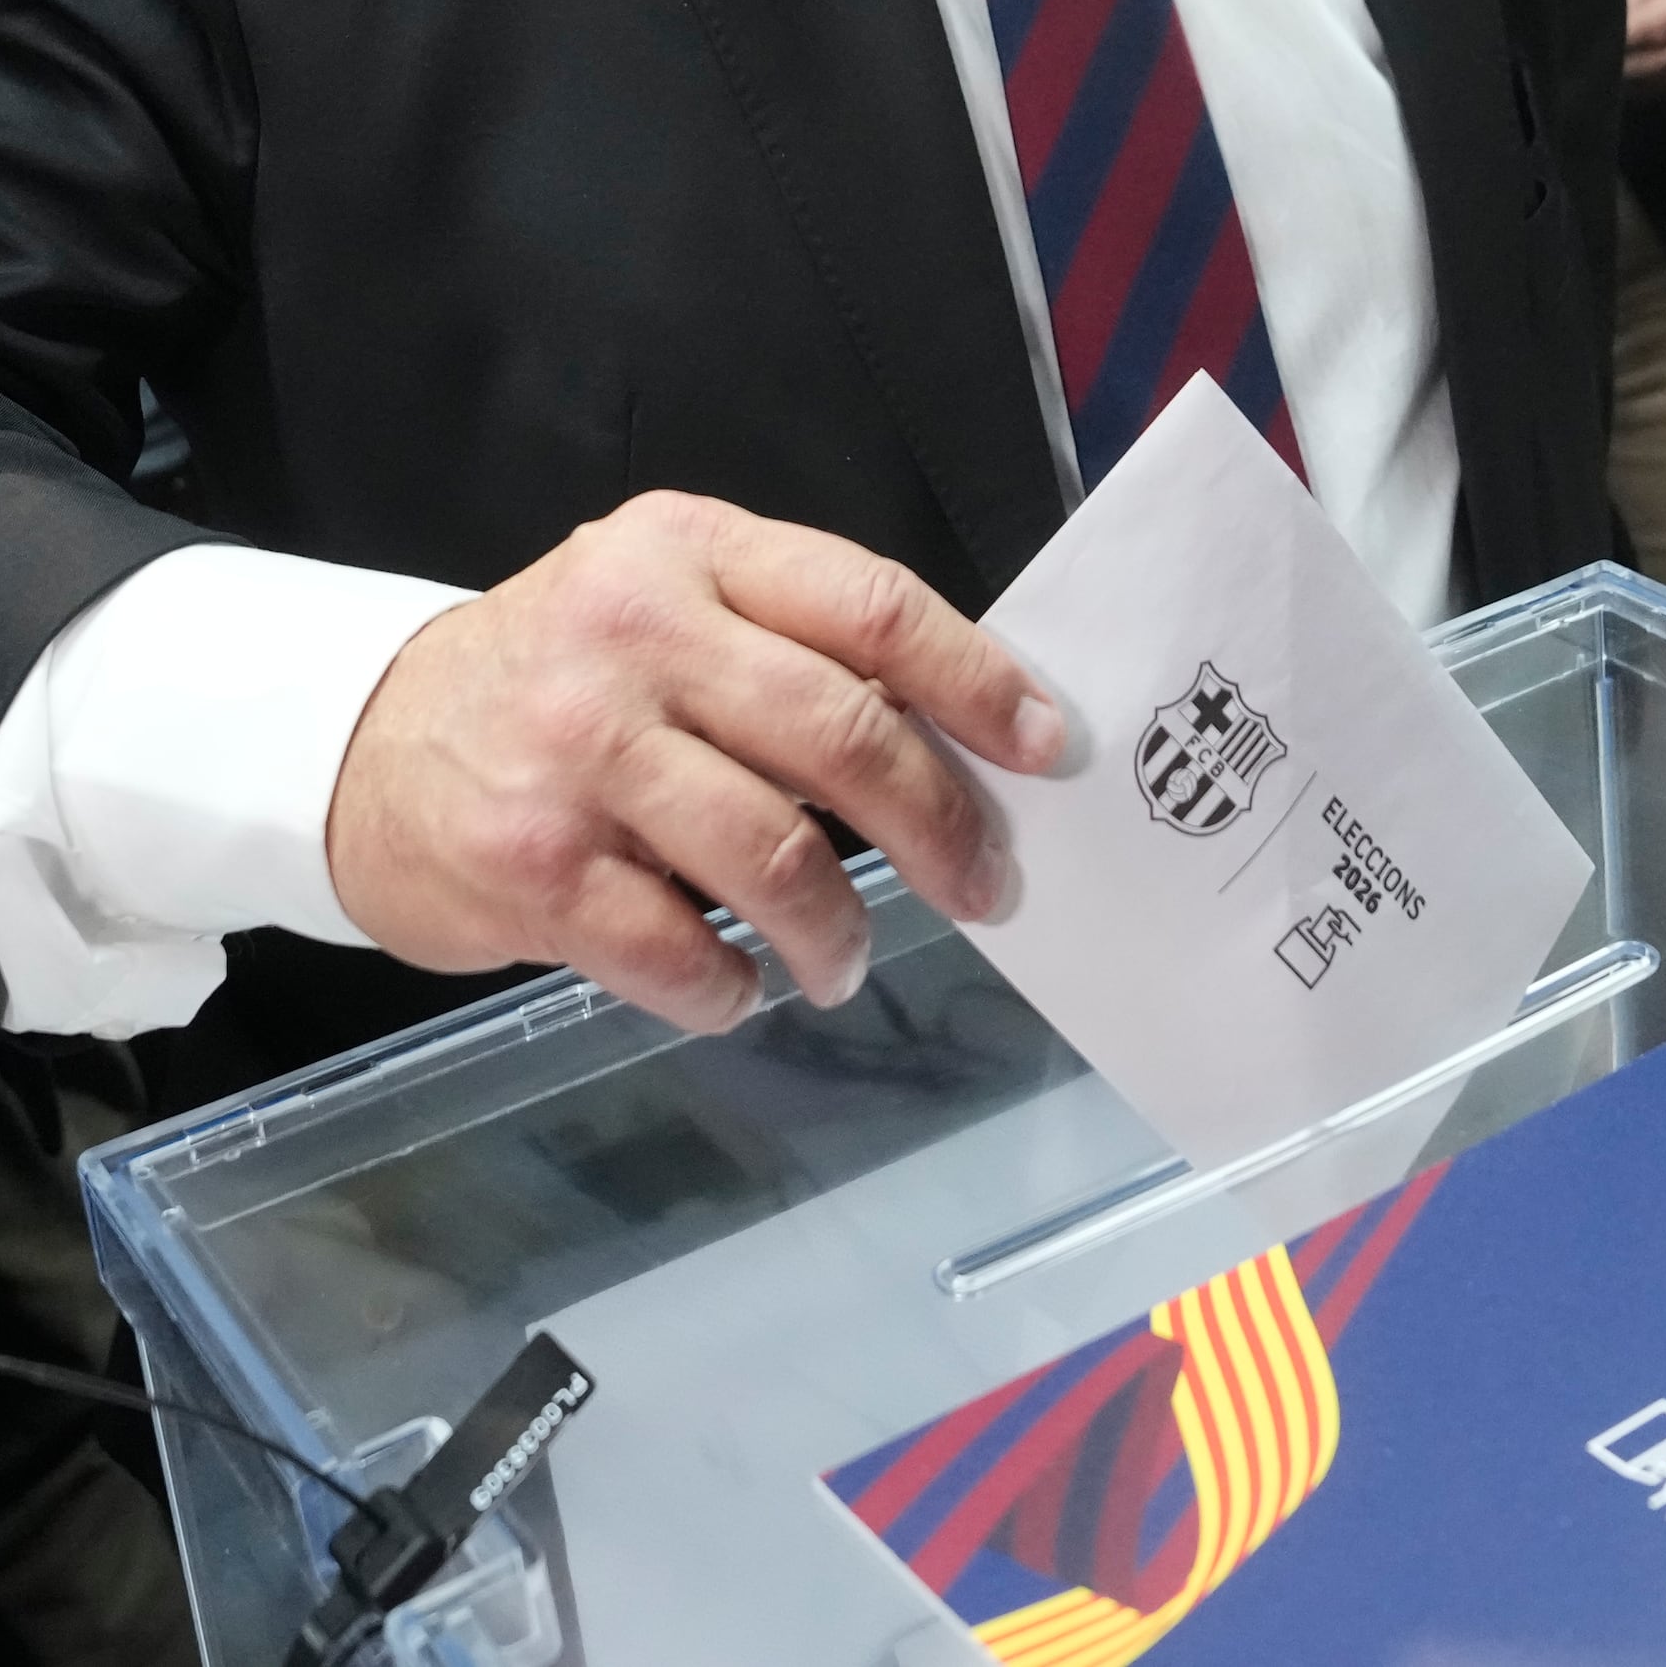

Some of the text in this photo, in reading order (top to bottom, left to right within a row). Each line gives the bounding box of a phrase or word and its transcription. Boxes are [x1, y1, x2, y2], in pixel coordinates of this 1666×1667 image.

[1184, 734, 1225, 778] FCB
[1321, 796, 1426, 921] ELECCIONS
[1331, 854, 1382, 915] 2026
